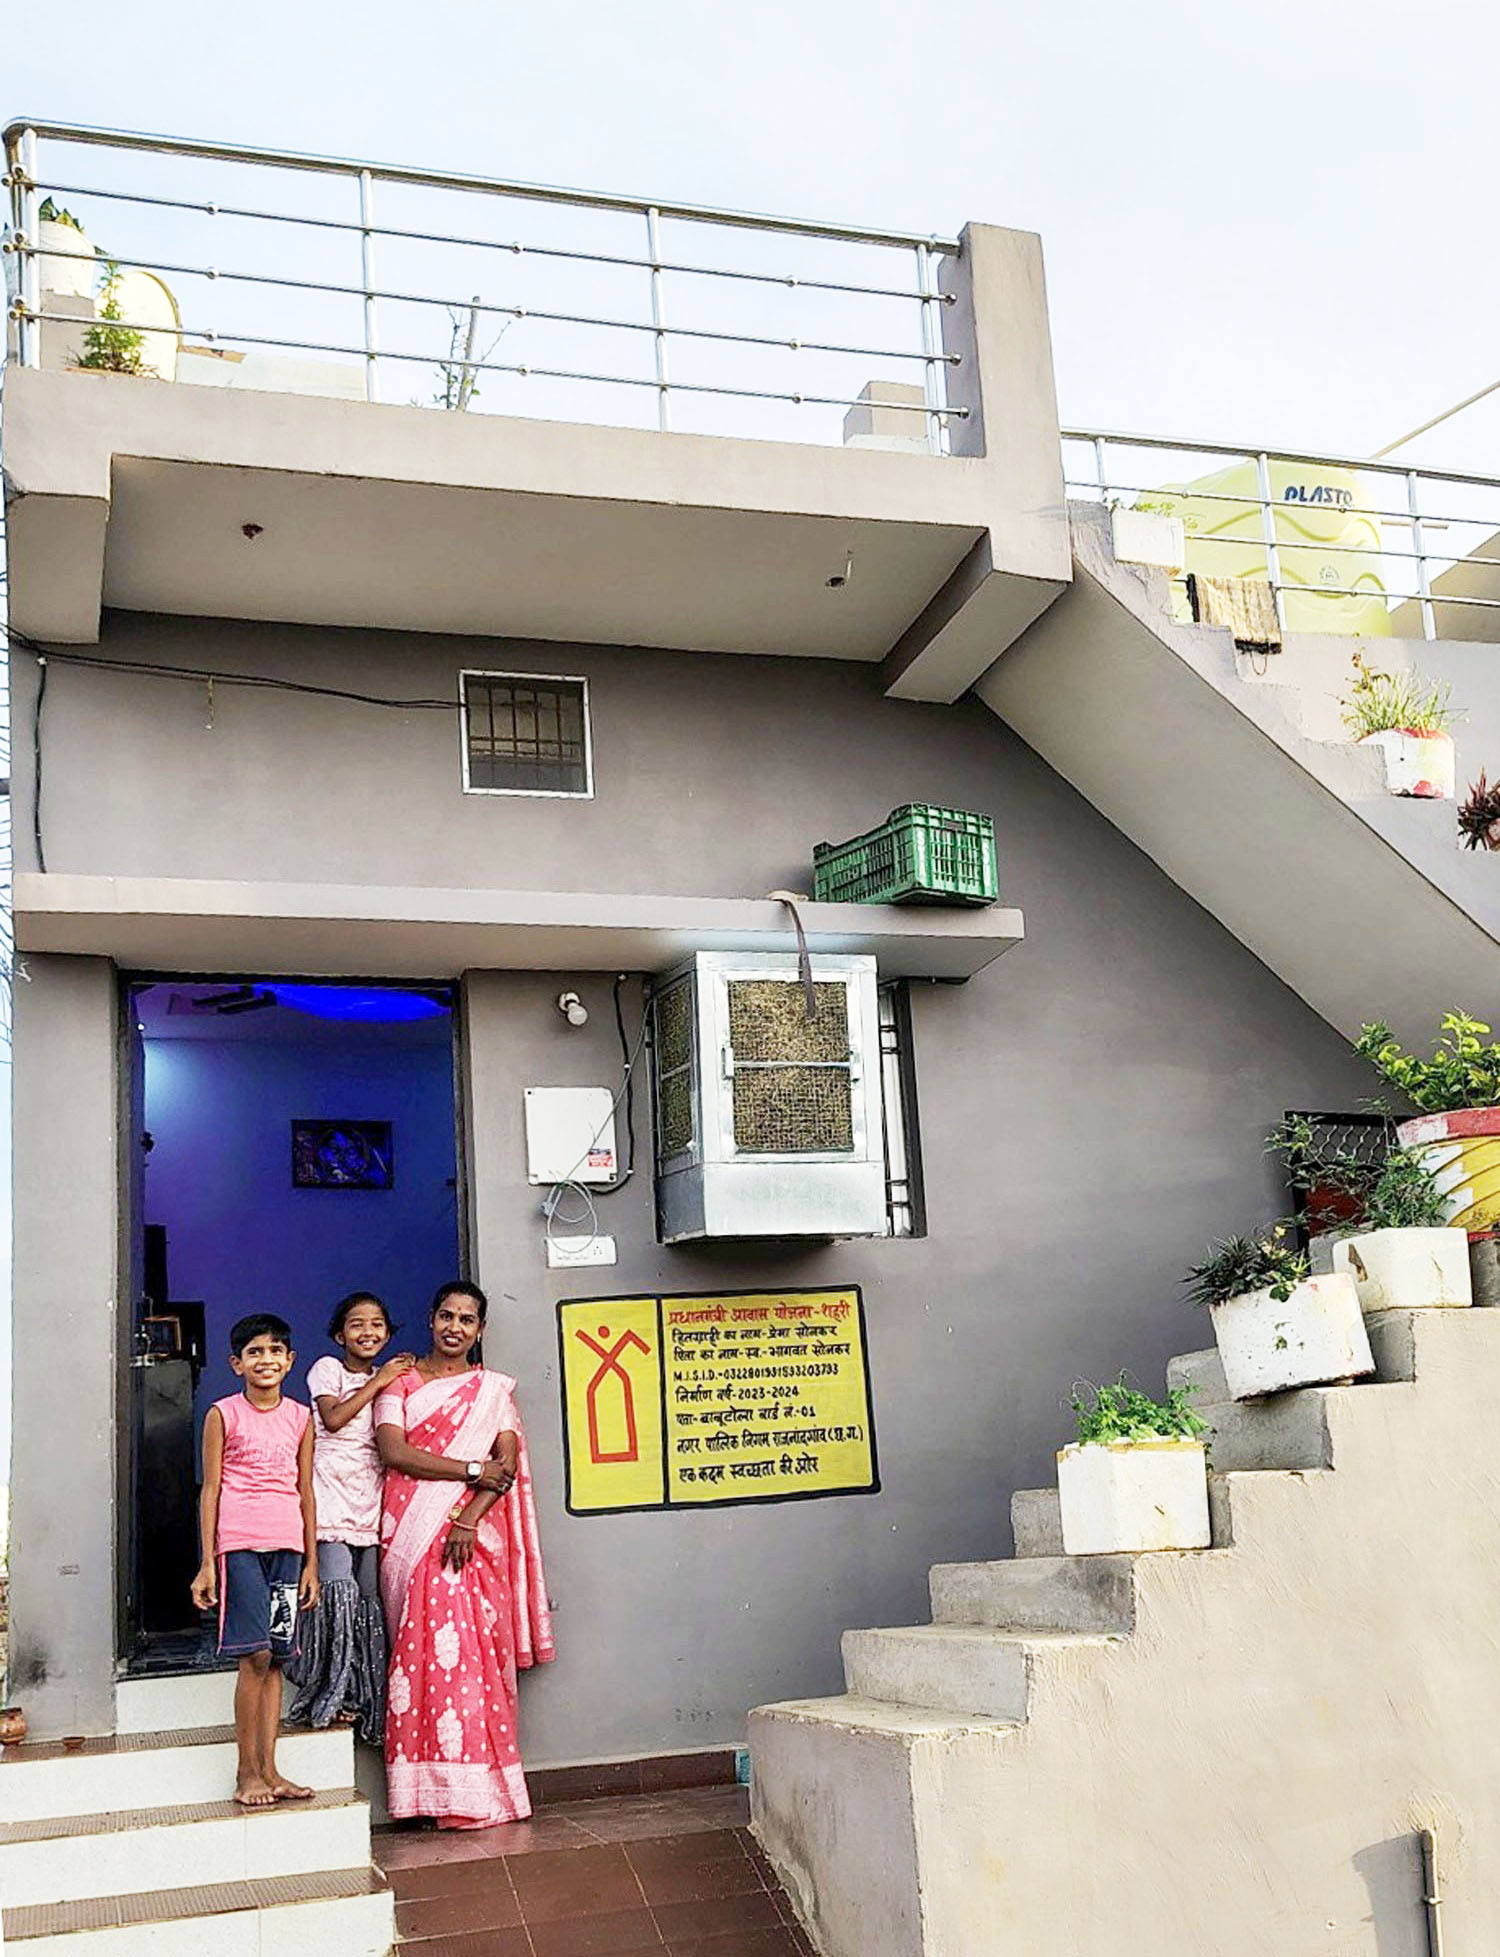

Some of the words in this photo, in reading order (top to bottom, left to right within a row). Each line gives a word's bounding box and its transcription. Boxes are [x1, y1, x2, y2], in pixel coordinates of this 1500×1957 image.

[1284, 485, 1353, 506] PLASTO
[730, 1307, 769, 1322] आवास
[674, 1345, 696, 1361] पिता
[699, 1348, 715, 1360] का
[675, 1384, 713, 1403] निर्माण
[758, 1401, 779, 1421] वार्ड
[677, 1437, 702, 1453] नगर
[742, 1428, 770, 1448] निगम
[679, 1467, 697, 1482] एक
[698, 1465, 725, 1485] कदम
[730, 1459, 776, 1480] स्वच्छता
[780, 1452, 793, 1475] की
[795, 1451, 819, 1475] ओर
